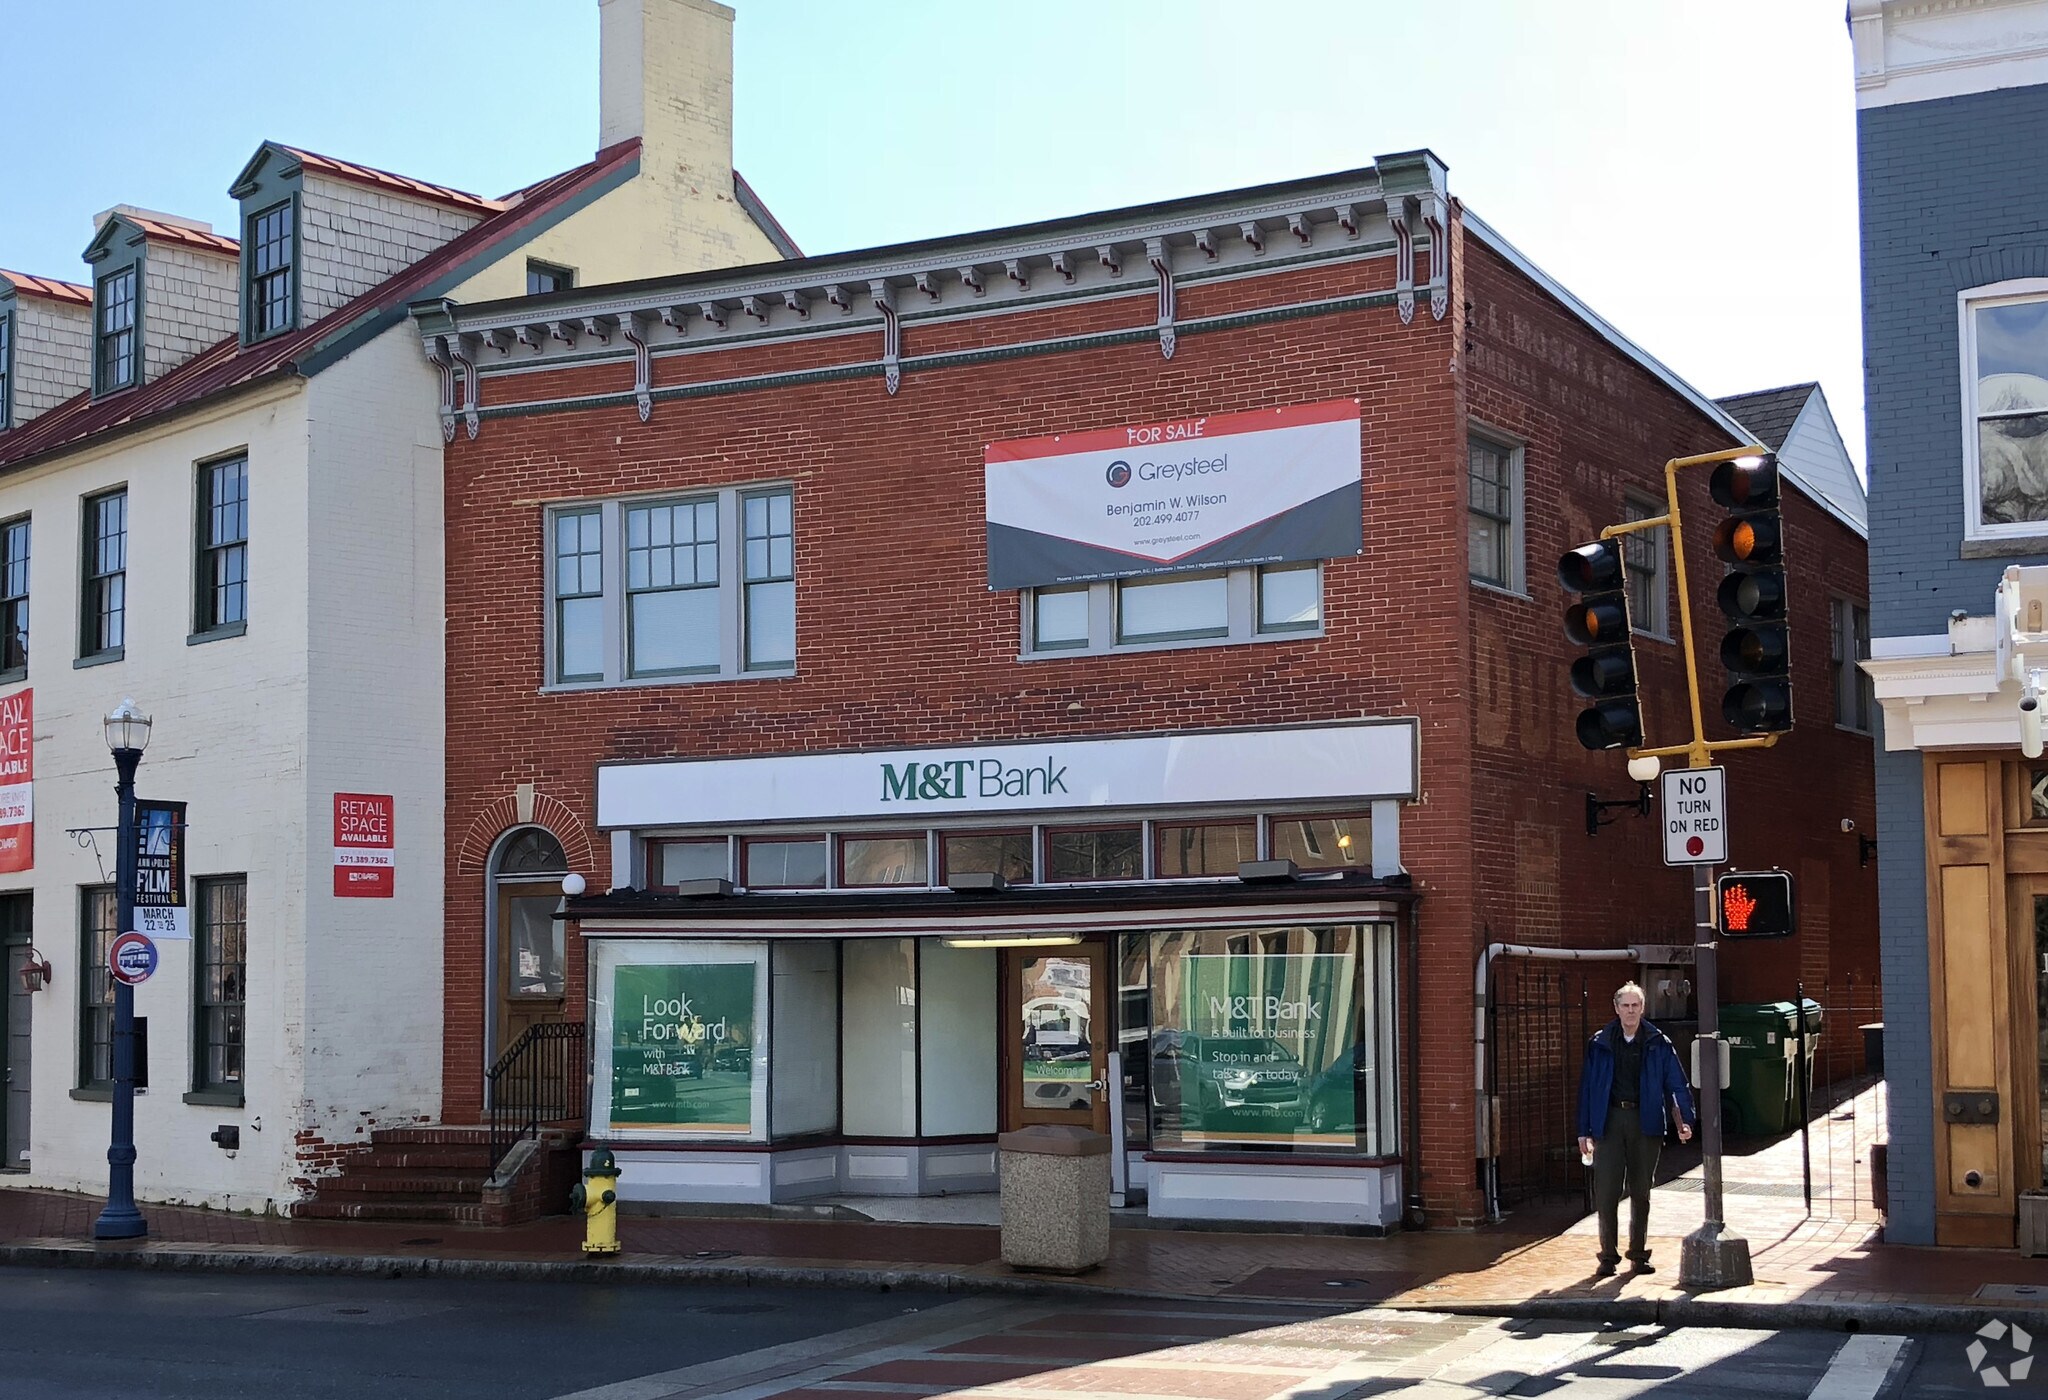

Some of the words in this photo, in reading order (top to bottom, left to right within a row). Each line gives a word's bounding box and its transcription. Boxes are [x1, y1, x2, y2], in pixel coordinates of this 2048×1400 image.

[1128, 427, 1161, 445] FOR
[1166, 422, 1203, 440] SALE
[1138, 453, 1228, 482] Greysteel
[1106, 499, 1166, 516] Benjamin
[1169, 496, 1182, 509] W.
[1186, 493, 1227, 508] Wilson
[1133, 510, 1200, 527] 202.499.4077
[1134, 532, 1201, 546] www.greysteel.com
[880, 759, 975, 801] M&T
[979, 755, 1069, 797] Bank
[1679, 776, 1707, 795] NO
[340, 800, 387, 816] RETAIL
[1677, 799, 1711, 814] TURN
[340, 816, 387, 832] SPACE
[1669, 819, 1687, 833] ON
[1694, 818, 1719, 832] RED
[341, 833, 387, 843] AVAILABLE
[136, 869, 170, 893] FILM
[136, 893, 170, 904] FESTIVAL
[143, 907, 174, 919] MARCH
[144, 919, 156, 931] 22
[165, 919, 176, 931] 25
[643, 992, 693, 1017] Look
[1210, 996, 1261, 1019] M&T
[1266, 995, 1321, 1019] Bank
[643, 1016, 726, 1040] Forward
[1211, 1027, 1220, 1038] is
[1222, 1026, 1247, 1038] built
[1249, 1026, 1265, 1038] for
[1268, 1026, 1316, 1038] business
[643, 1047, 666, 1059] with
[1212, 1051, 1238, 1065] Stop
[1240, 1050, 1251, 1062] in
[1253, 1050, 1274, 1062] and
[642, 1063, 666, 1075] M&T
[666, 1063, 690, 1076] Bank
[1036, 1064, 1078, 1076] Welcome
[1232, 1108, 1303, 1118] www.mtb.com
